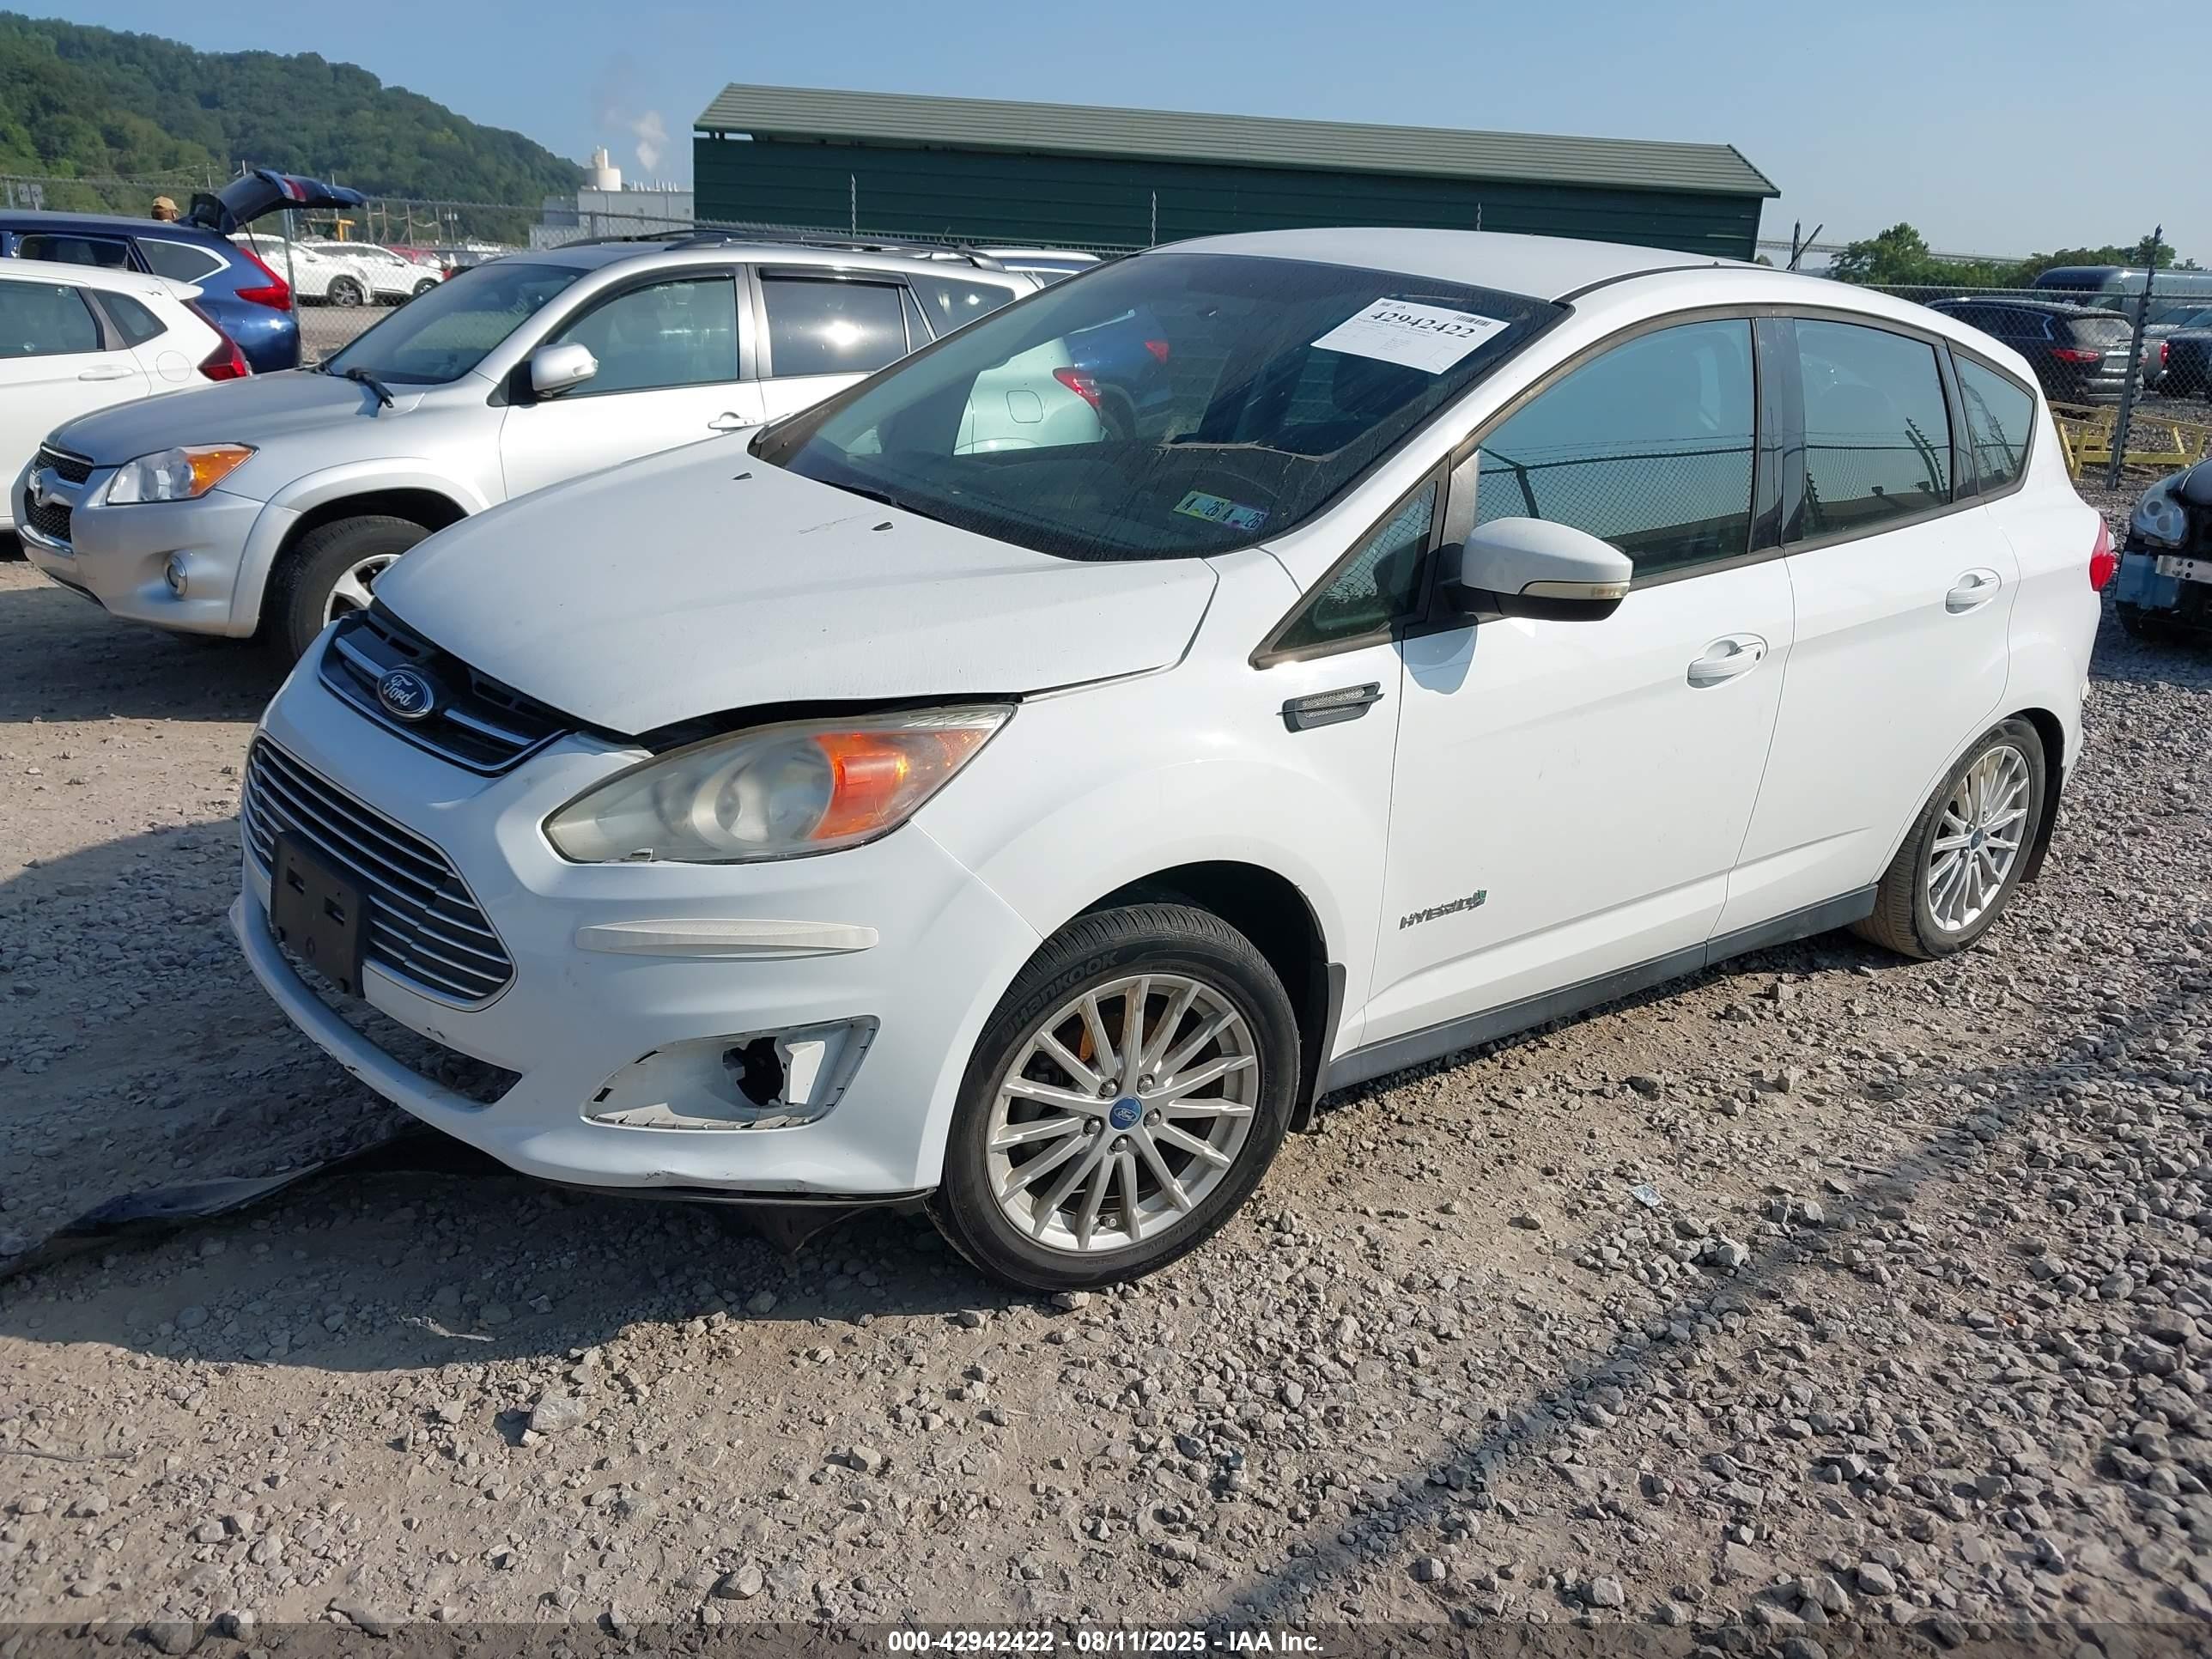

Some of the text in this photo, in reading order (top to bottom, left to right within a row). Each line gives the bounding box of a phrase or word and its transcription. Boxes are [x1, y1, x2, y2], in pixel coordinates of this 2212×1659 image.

[1370, 310, 1476, 338] 42942422
[1182, 497, 1225, 517] 4 26
[383, 674, 418, 707] Ford
